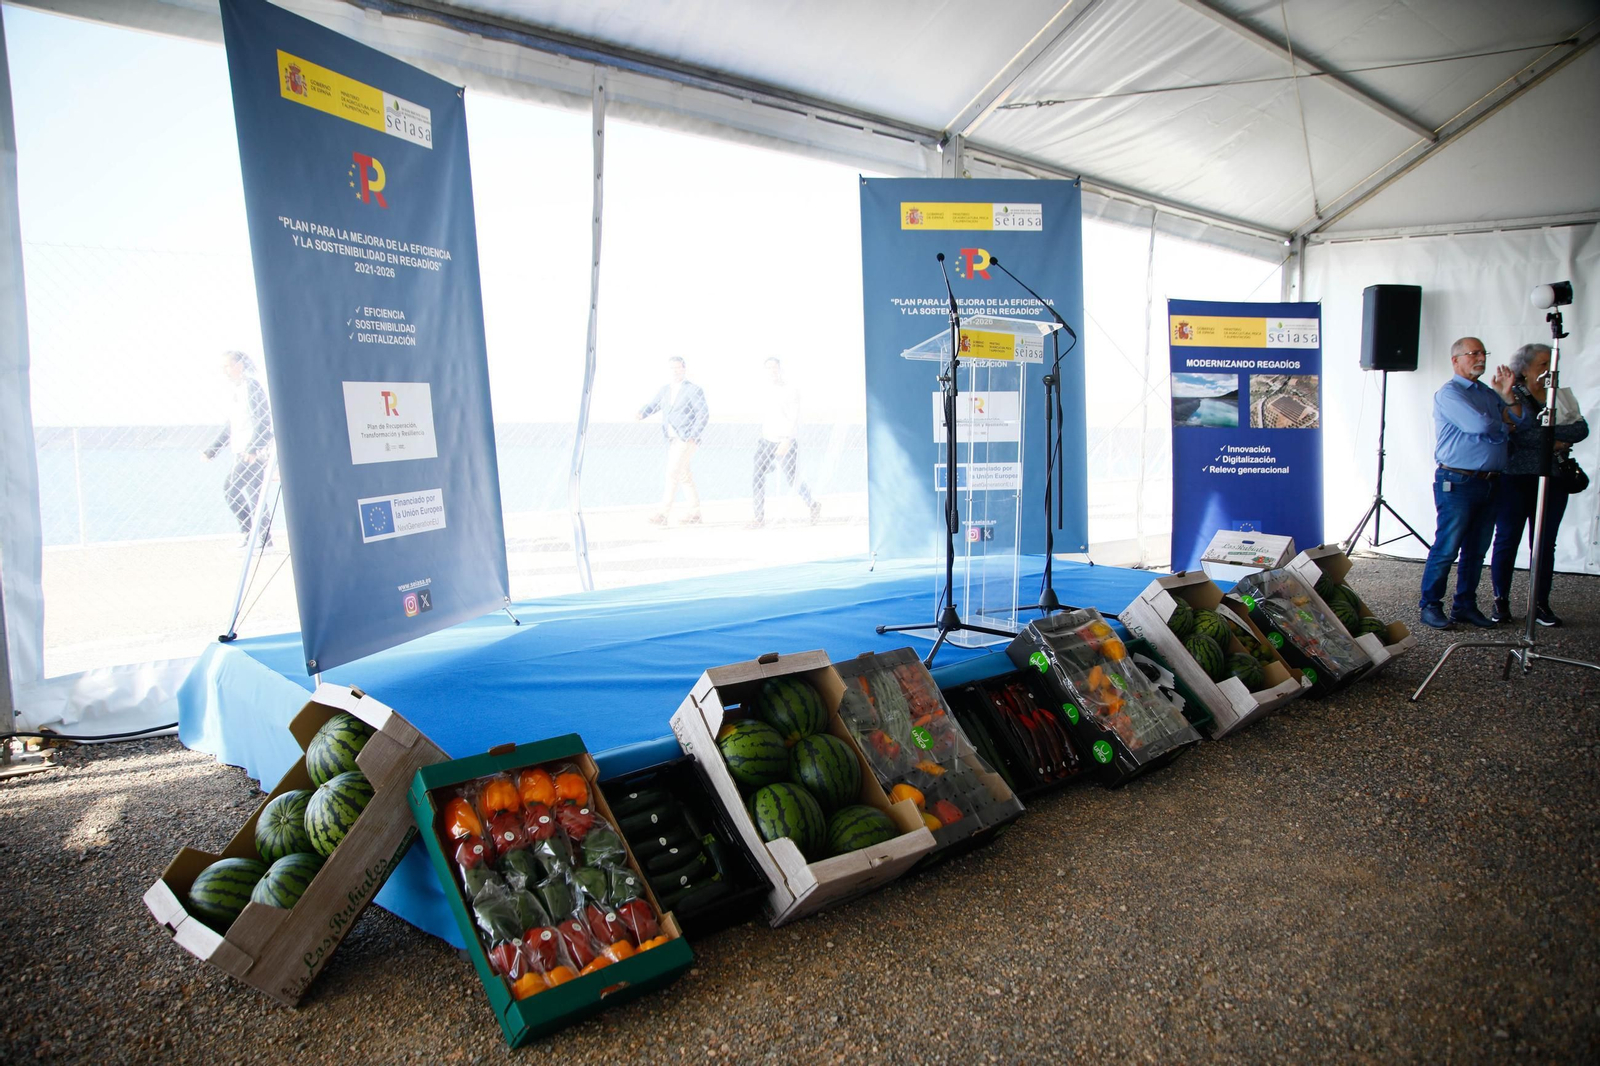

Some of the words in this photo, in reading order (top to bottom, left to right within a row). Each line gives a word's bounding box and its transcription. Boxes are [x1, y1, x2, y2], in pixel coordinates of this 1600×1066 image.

[386, 114, 431, 142] seiasa
[995, 214, 1042, 226] seiasa
[310, 222, 336, 238] PARA
[337, 228, 349, 241] LA
[350, 232, 385, 248] MEJORA
[386, 239, 398, 250] DE
[398, 241, 410, 253] LA
[410, 244, 452, 260] EFICIENCIA
[292, 234, 299, 246] Y
[300, 236, 314, 250] LA
[314, 239, 386, 263] SOSTENIBILIDAD
[387, 254, 398, 265] EN
[354, 262, 396, 278] 2021-2026
[364, 306, 405, 320] EFICIENCIA
[355, 319, 416, 334] SOSTENIBILIDAD
[357, 332, 416, 346] DIGITALIZACIÓN
[1268, 330, 1318, 343] seiasa
[1015, 346, 1043, 358] seiasa
[1186, 359, 1255, 368] MODERNIZANDO
[1257, 360, 1300, 369] REGADÍOS
[361, 430, 397, 438] Transformación
[1222, 455, 1276, 465] Digitalización
[1238, 466, 1290, 475] generacional
[394, 496, 425, 507] Financiado
[426, 495, 436, 504] por
[402, 508, 420, 518] Unión
[420, 505, 443, 516] Europea
[397, 518, 440, 532] NextGenerationEU
[398, 578, 432, 592] www.seiasa.es
[1093, 745, 1106, 762] unica
[329, 858, 388, 934] Rubiales
